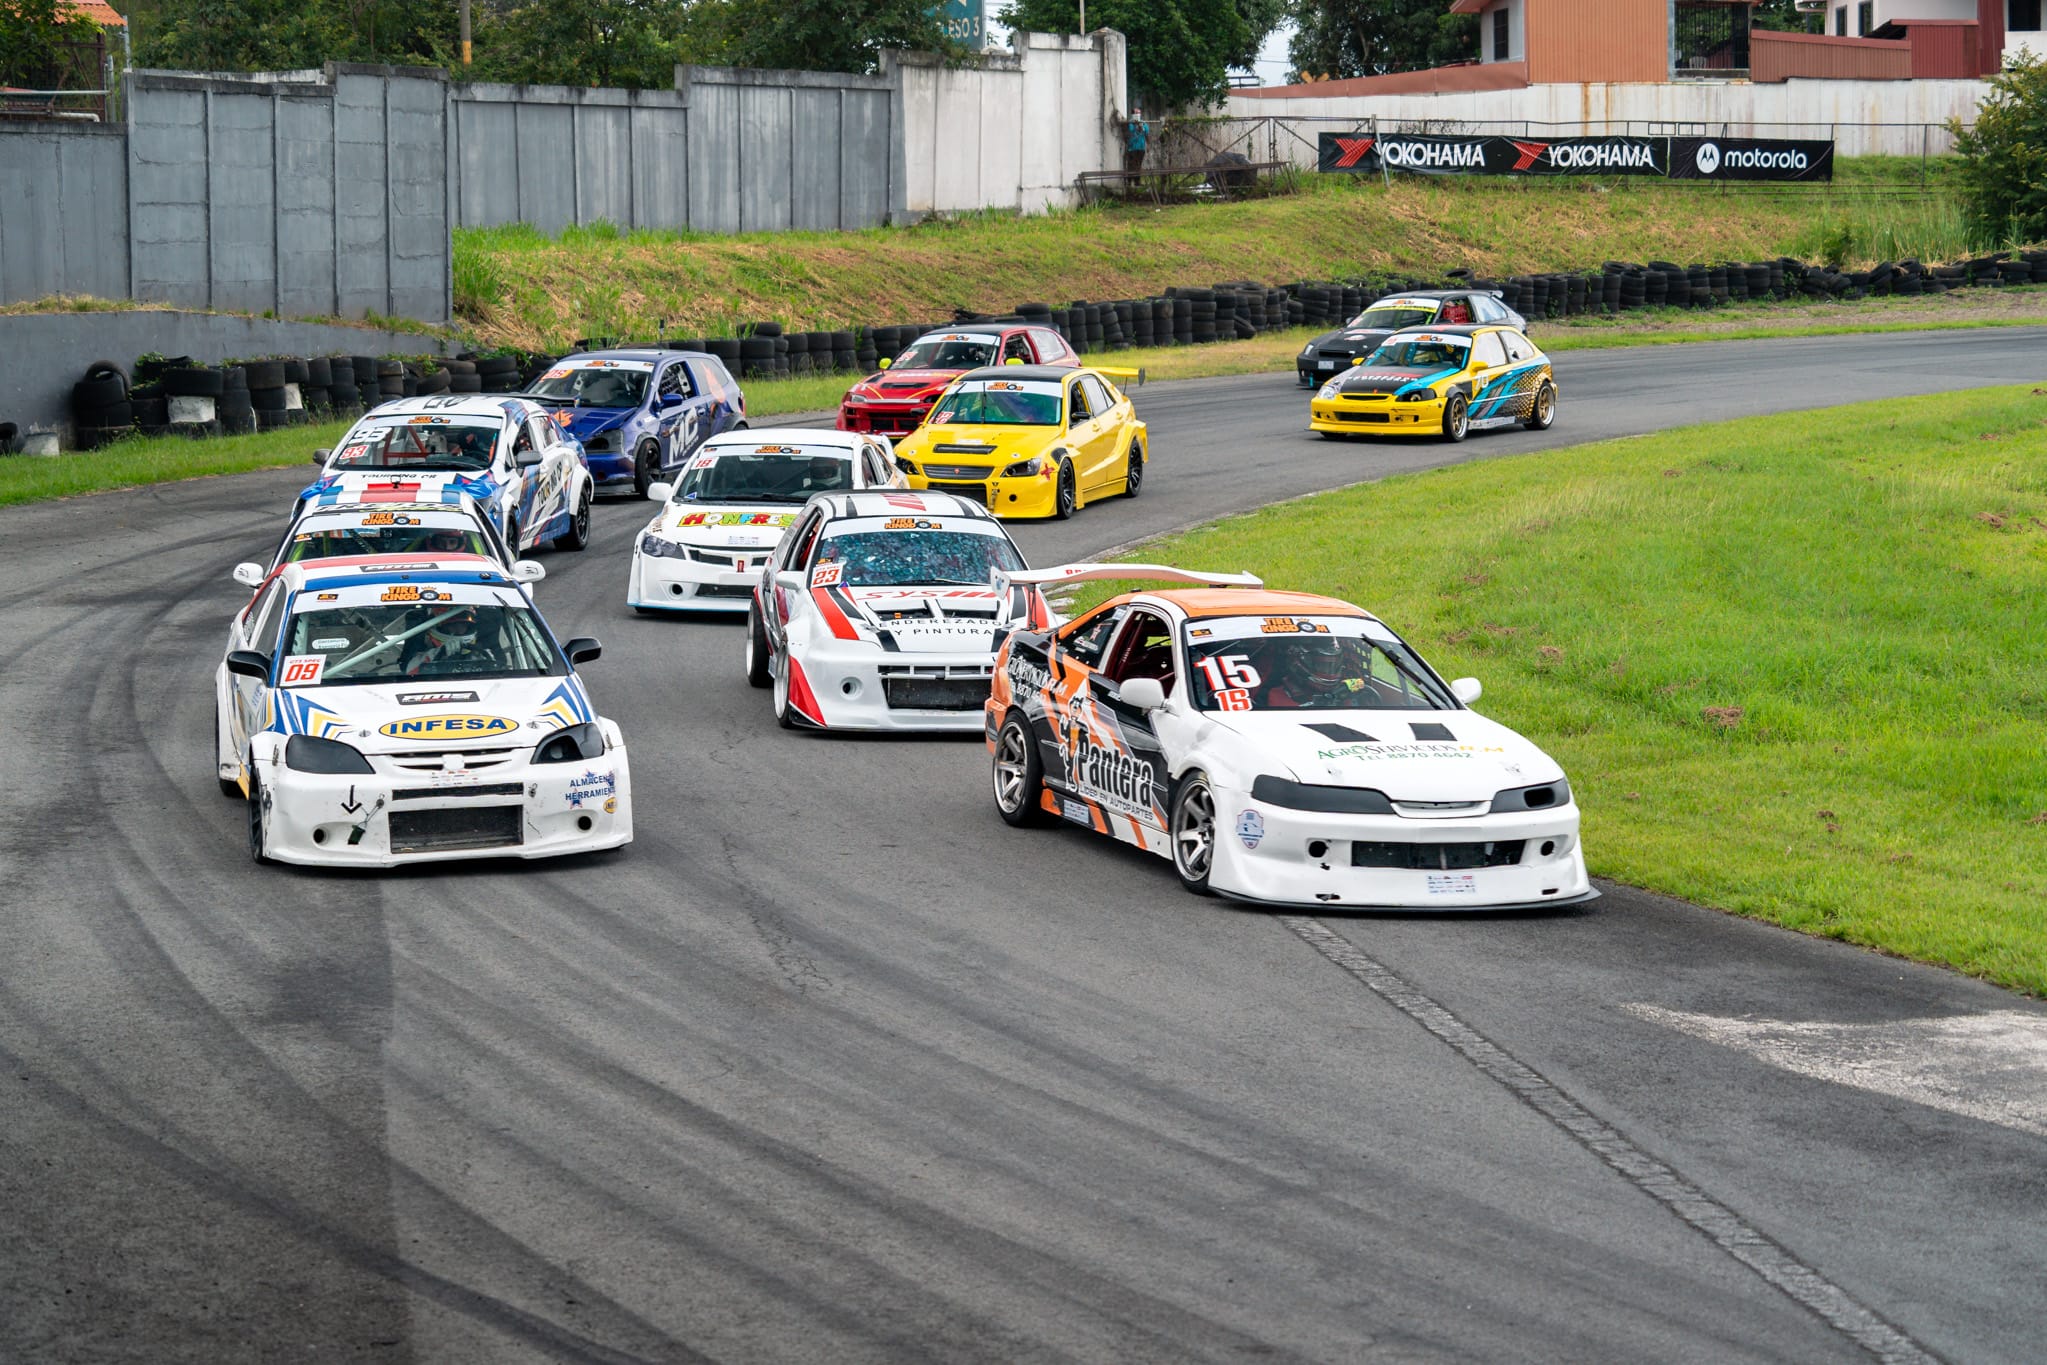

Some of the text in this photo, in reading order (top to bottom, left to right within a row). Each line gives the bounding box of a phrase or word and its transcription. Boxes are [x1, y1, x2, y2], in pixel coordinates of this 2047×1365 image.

[973, 16, 980, 37] 3
[1375, 142, 1485, 167] YOKOHAMA
[1549, 144, 1654, 168] YOKOHAMA
[1724, 149, 1807, 169] motorola
[341, 446, 367, 458] 93
[813, 569, 839, 585] 23
[387, 586, 418, 594] TIRE
[1263, 617, 1294, 625] TIRE
[285, 663, 320, 682] 09
[1193, 654, 1261, 690] 15
[1214, 688, 1252, 711] 15
[390, 719, 507, 735] INFESA
[1077, 735, 1153, 809] Pantera
